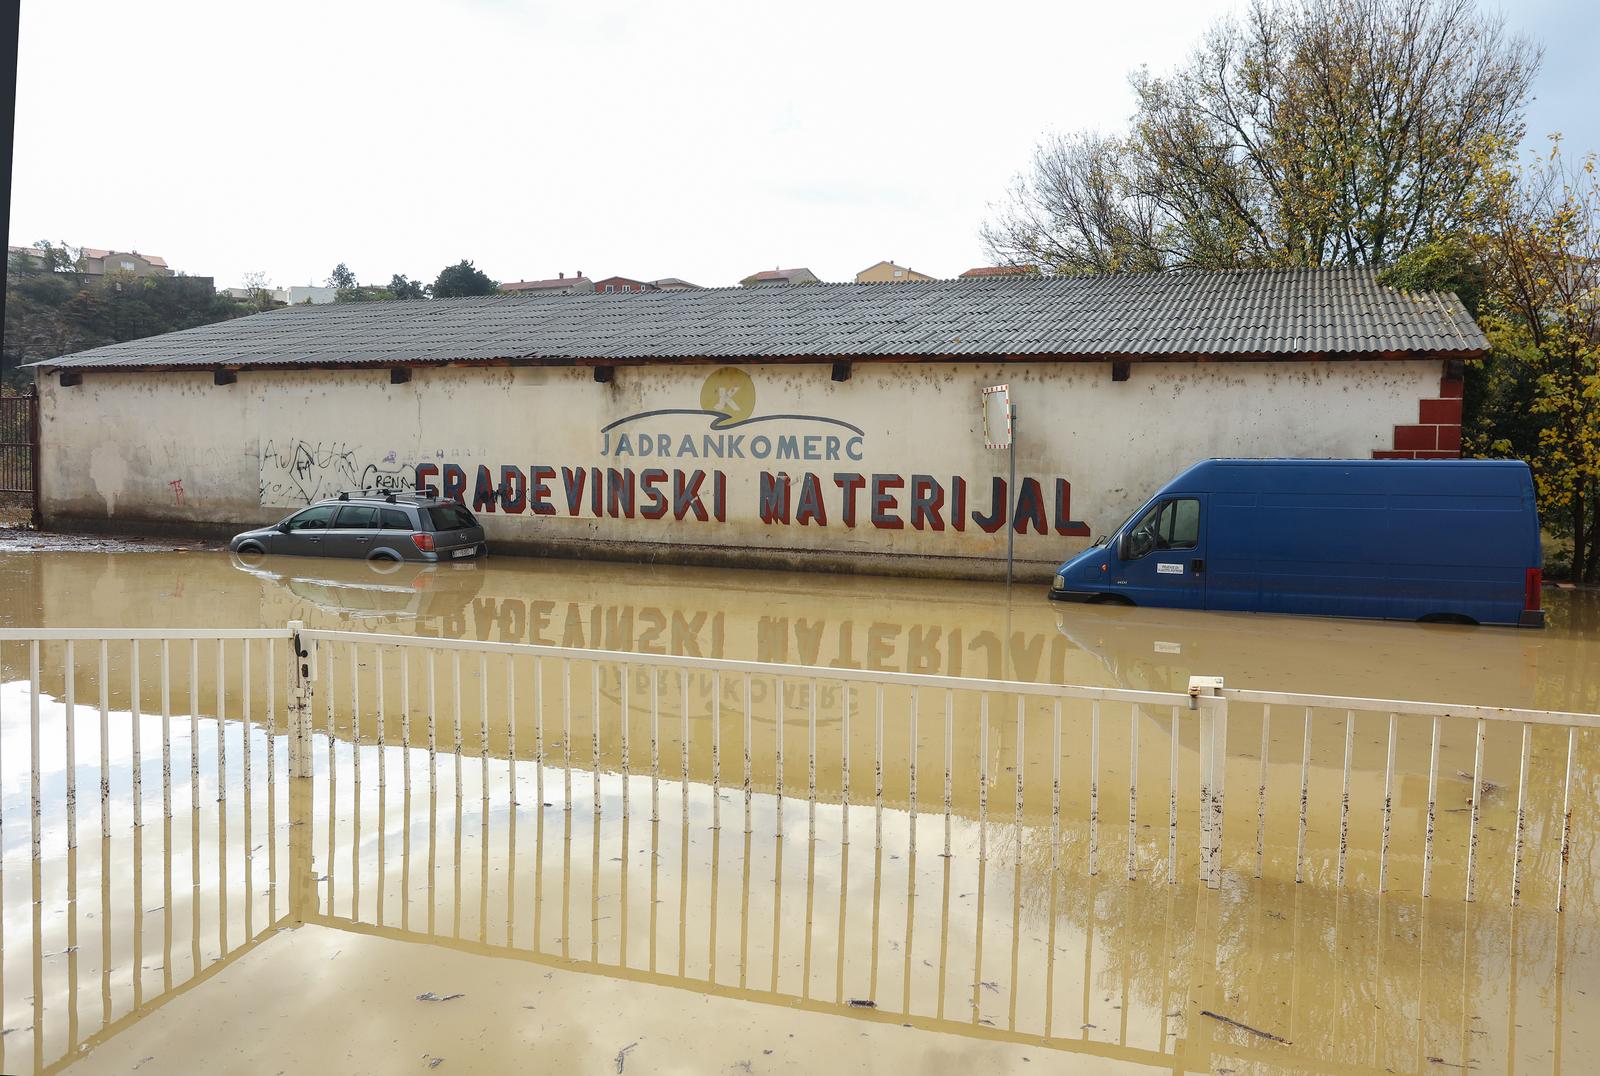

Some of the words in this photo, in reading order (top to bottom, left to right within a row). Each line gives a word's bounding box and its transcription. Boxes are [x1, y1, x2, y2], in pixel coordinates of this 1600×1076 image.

[713, 385, 743, 412] K
[601, 432, 864, 461] JADRANKOMERC
[759, 471, 1091, 537] MATERIJAL
